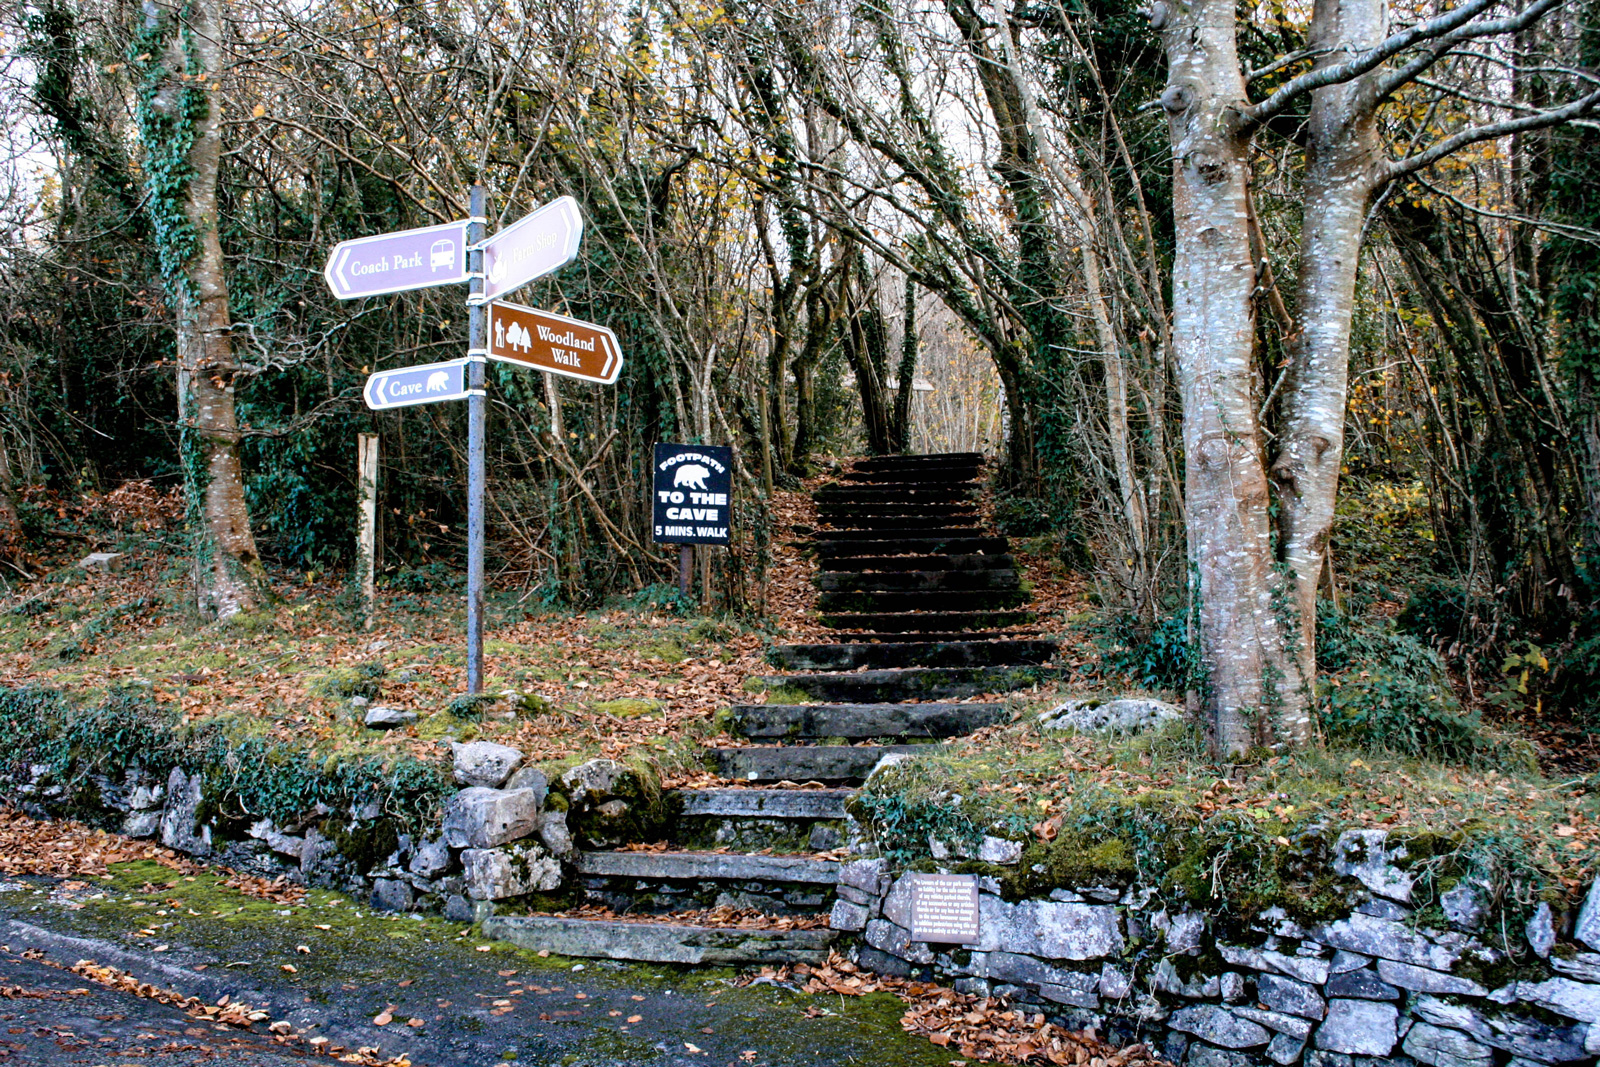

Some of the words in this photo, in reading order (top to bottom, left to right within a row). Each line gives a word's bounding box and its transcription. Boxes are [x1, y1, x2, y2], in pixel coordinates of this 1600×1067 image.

[512, 246, 535, 264] Farm
[536, 231, 558, 252] Shop
[350, 254, 390, 277] Coach
[392, 252, 423, 270] Park
[536, 324, 595, 352] Woodland
[551, 347, 581, 368] Walk
[389, 380, 423, 397] Cave
[658, 452, 726, 474] FOOTPATH
[658, 490, 685, 504] TO
[689, 492, 727, 506] THE
[665, 507, 719, 521] CAVE
[655, 525, 663, 536] 5
[664, 525, 696, 537] MINS.
[696, 526, 728, 538] WALK
